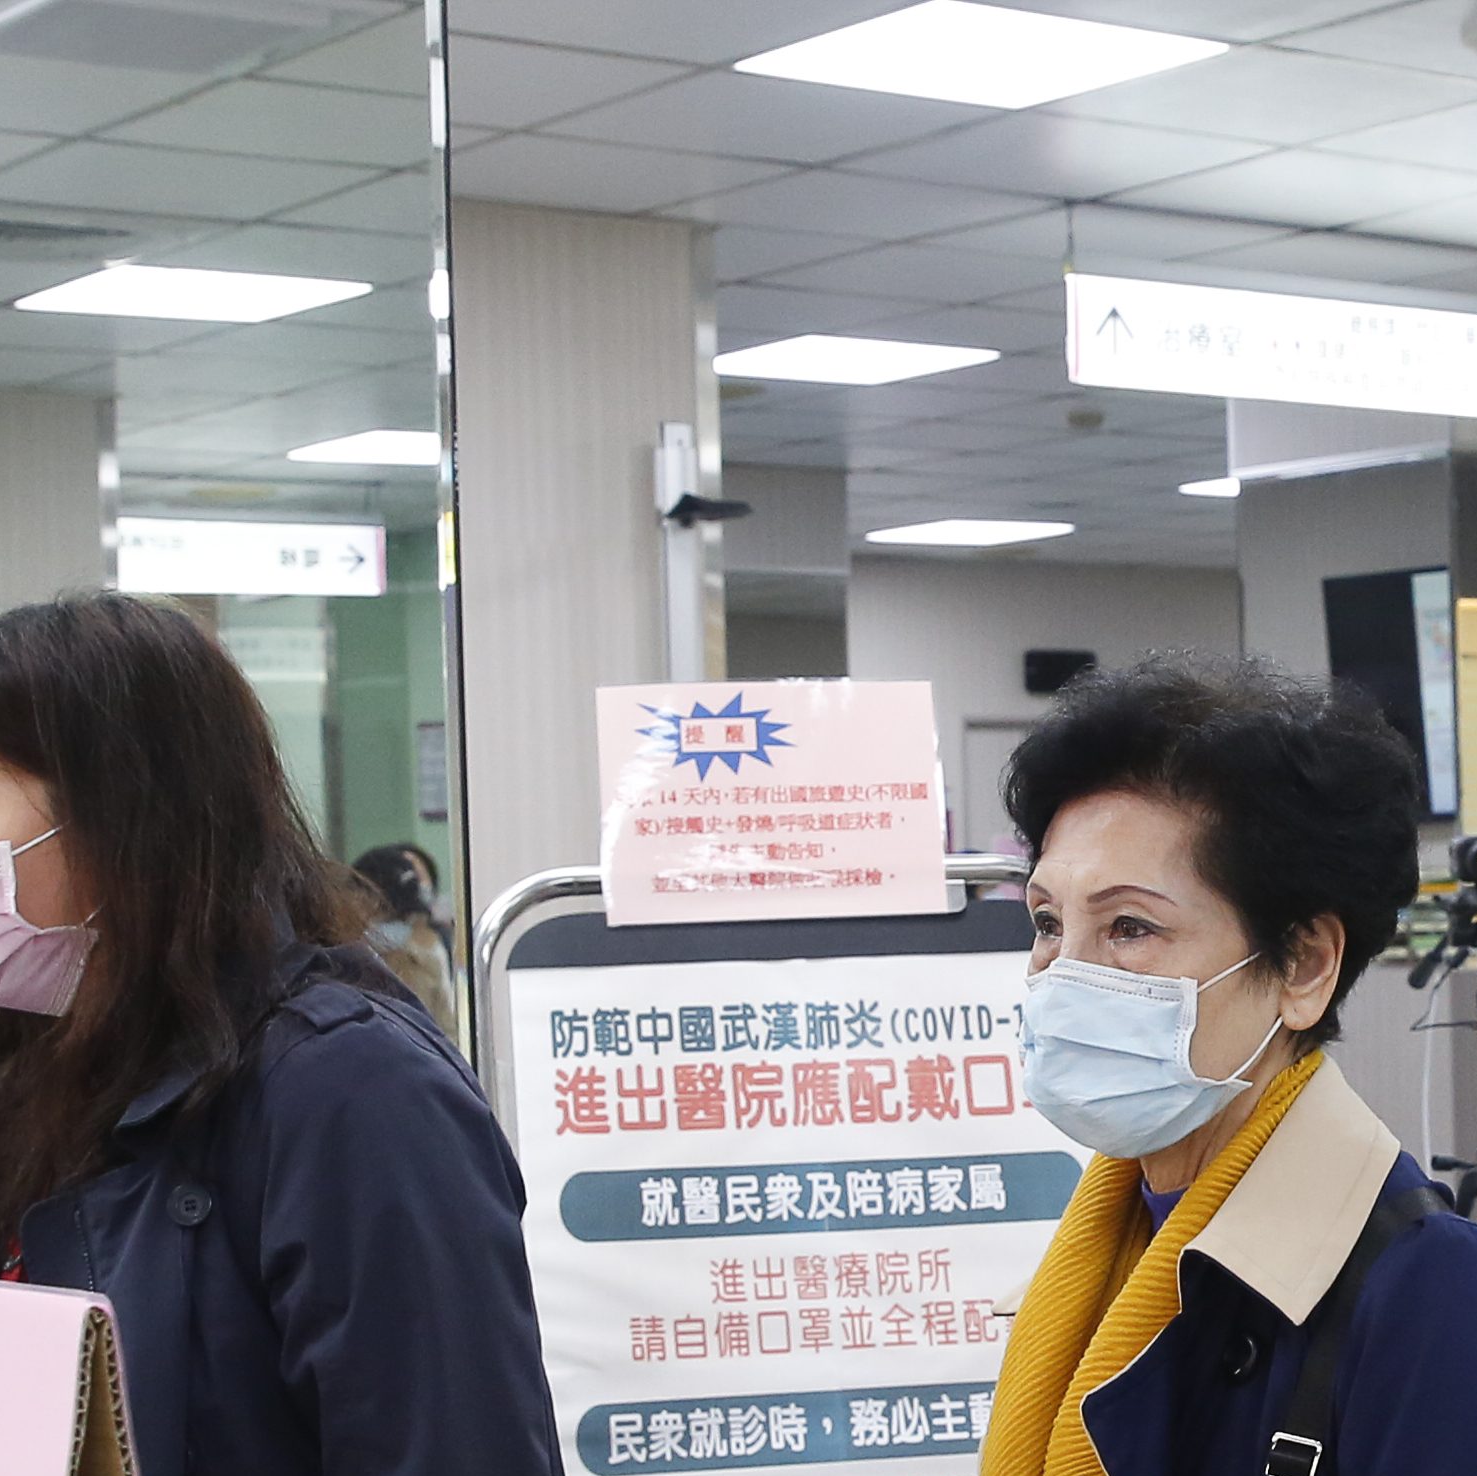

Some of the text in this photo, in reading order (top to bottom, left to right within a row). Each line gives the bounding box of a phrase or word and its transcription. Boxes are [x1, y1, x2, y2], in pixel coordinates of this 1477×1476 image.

[555, 1053, 1032, 1135] 進出醫院應配戴口
[710, 1248, 953, 1305] 進出醫療院所
[629, 1299, 1014, 1362] 請自備口罩並全程配
